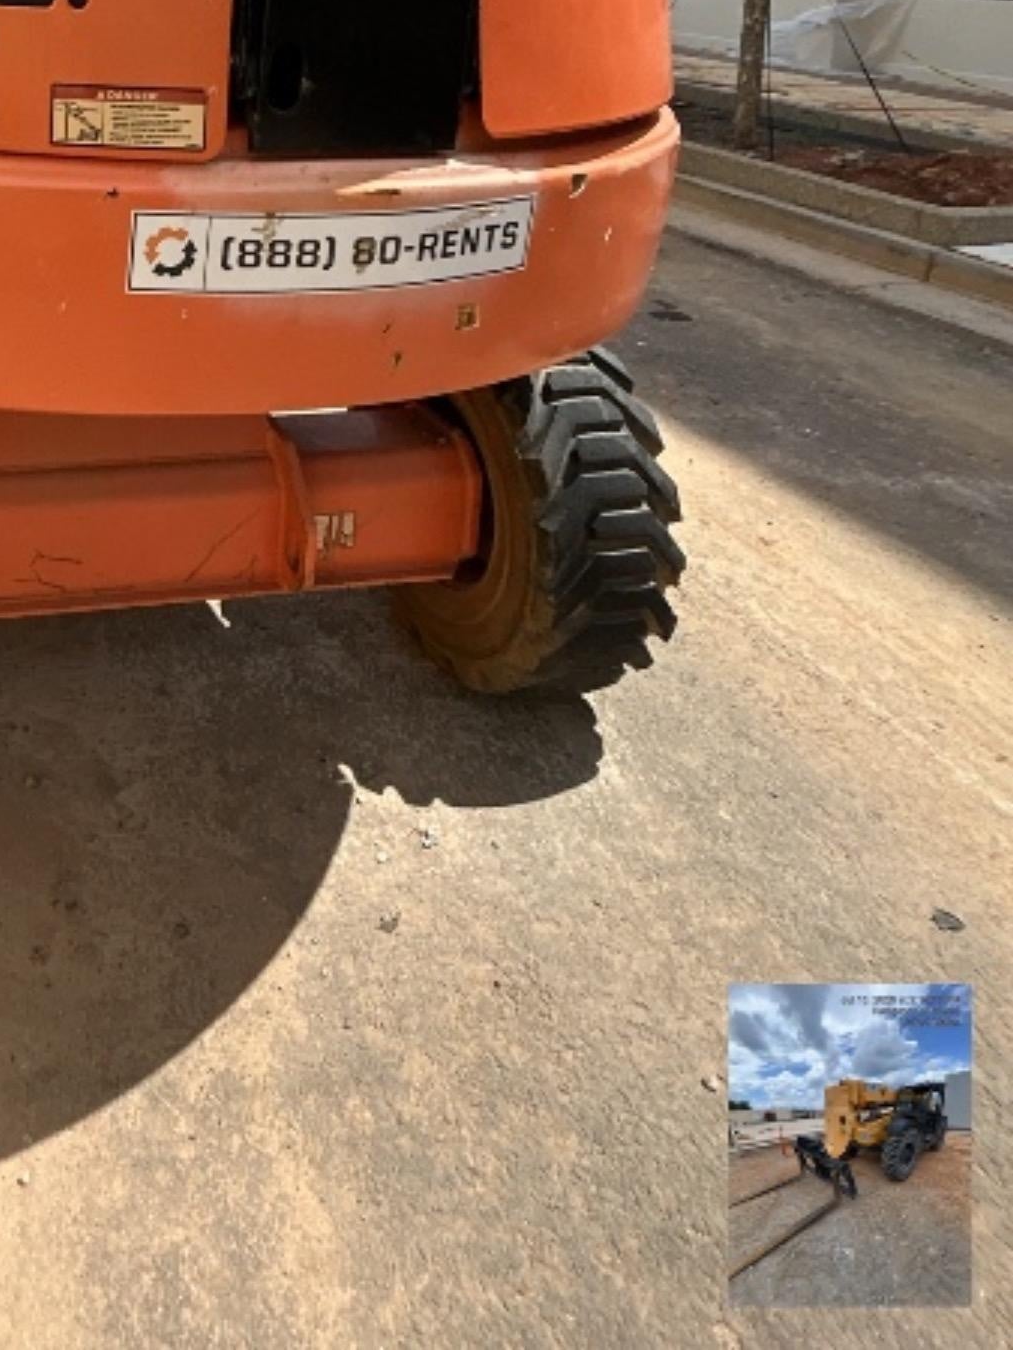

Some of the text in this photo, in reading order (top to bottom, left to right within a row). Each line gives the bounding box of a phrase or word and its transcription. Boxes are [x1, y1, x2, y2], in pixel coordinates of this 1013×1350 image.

[107, 90, 159, 100] DAN
[220, 221, 519, 271] (888) 80-RENTS
